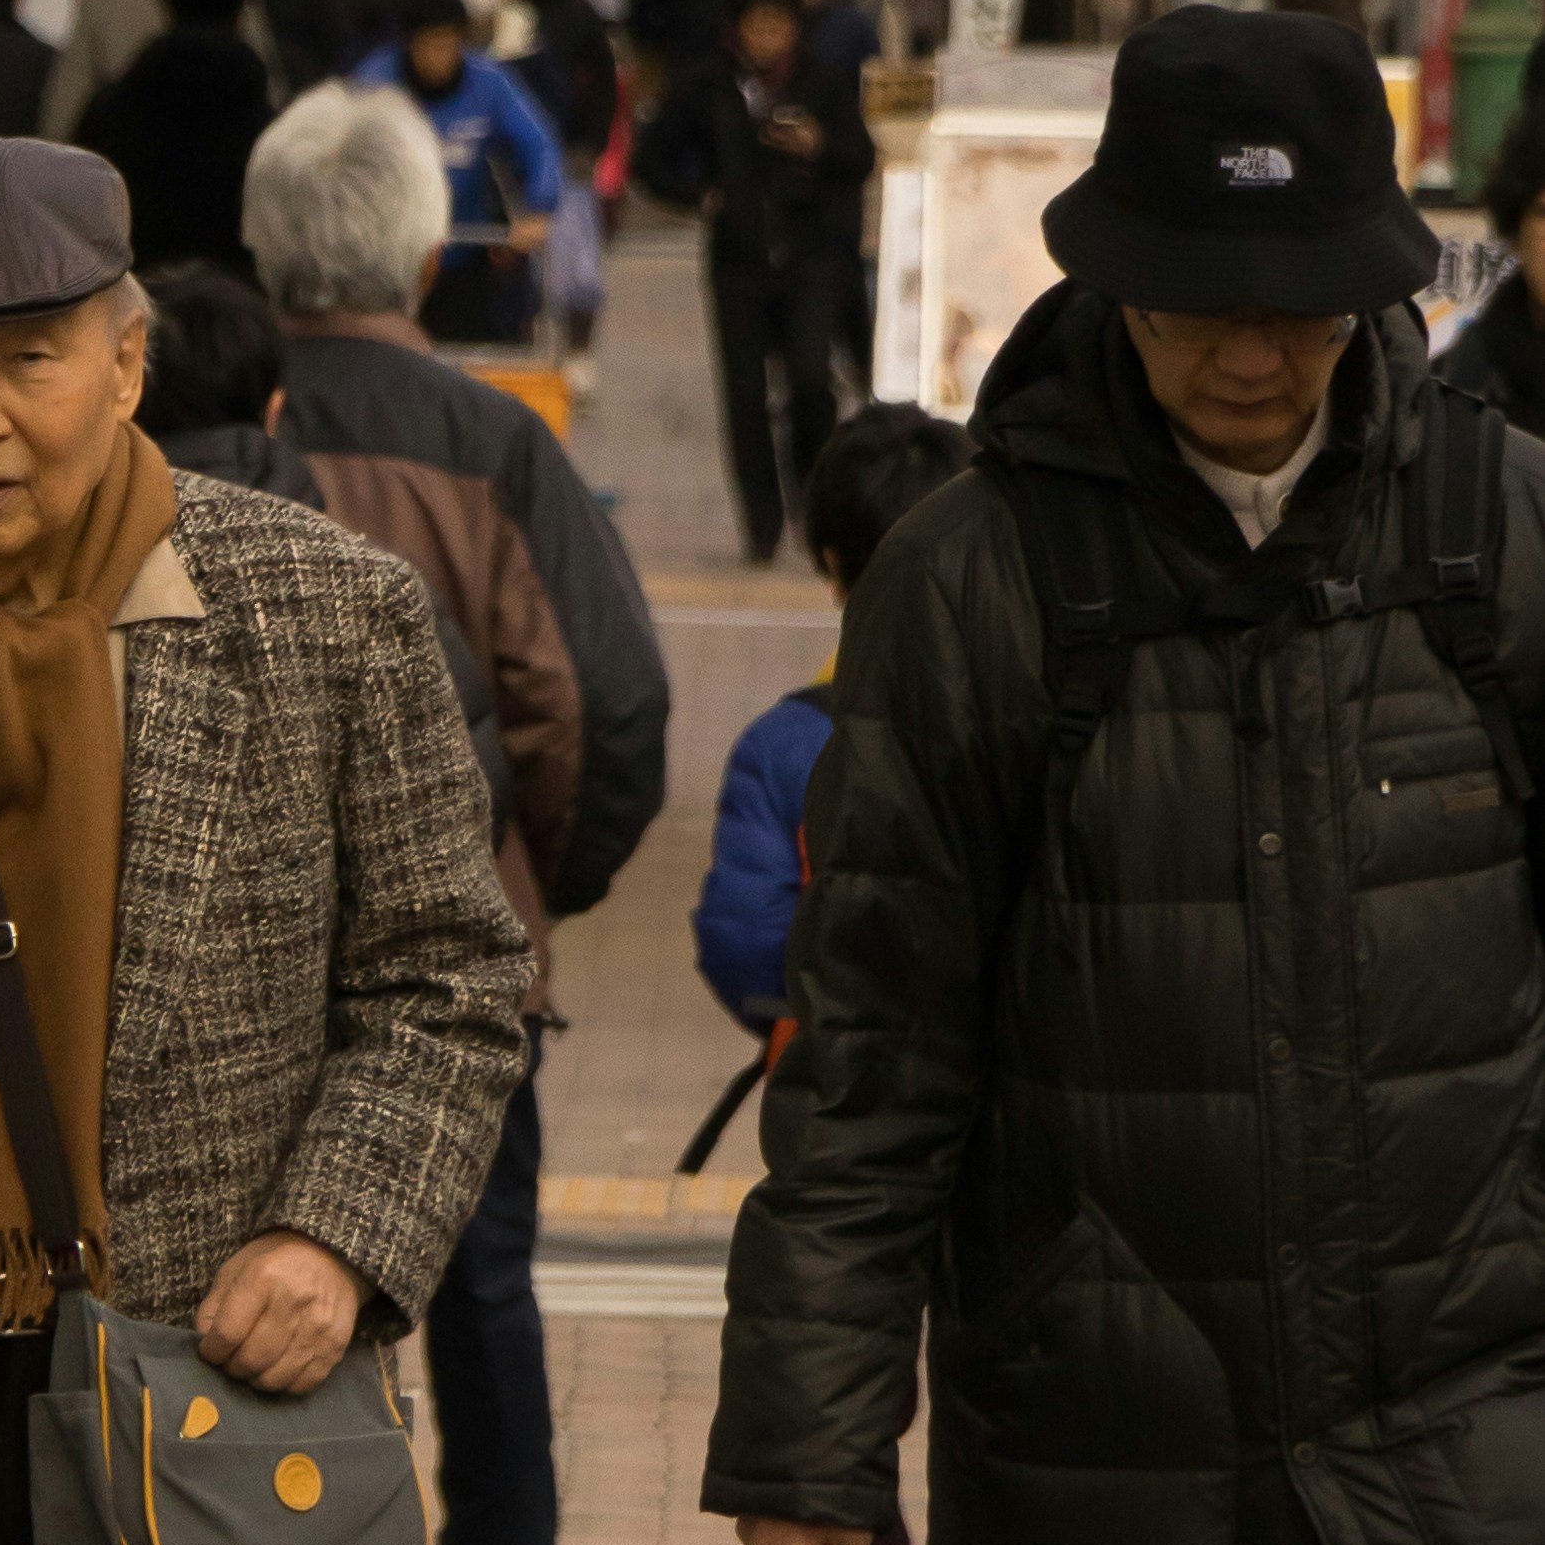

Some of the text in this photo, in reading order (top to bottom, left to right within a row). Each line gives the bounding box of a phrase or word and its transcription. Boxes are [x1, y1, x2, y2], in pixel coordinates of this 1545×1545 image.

[1240, 146, 1269, 160] THE
[1219, 156, 1269, 169] NORTH
[1234, 167, 1269, 180] FACE
